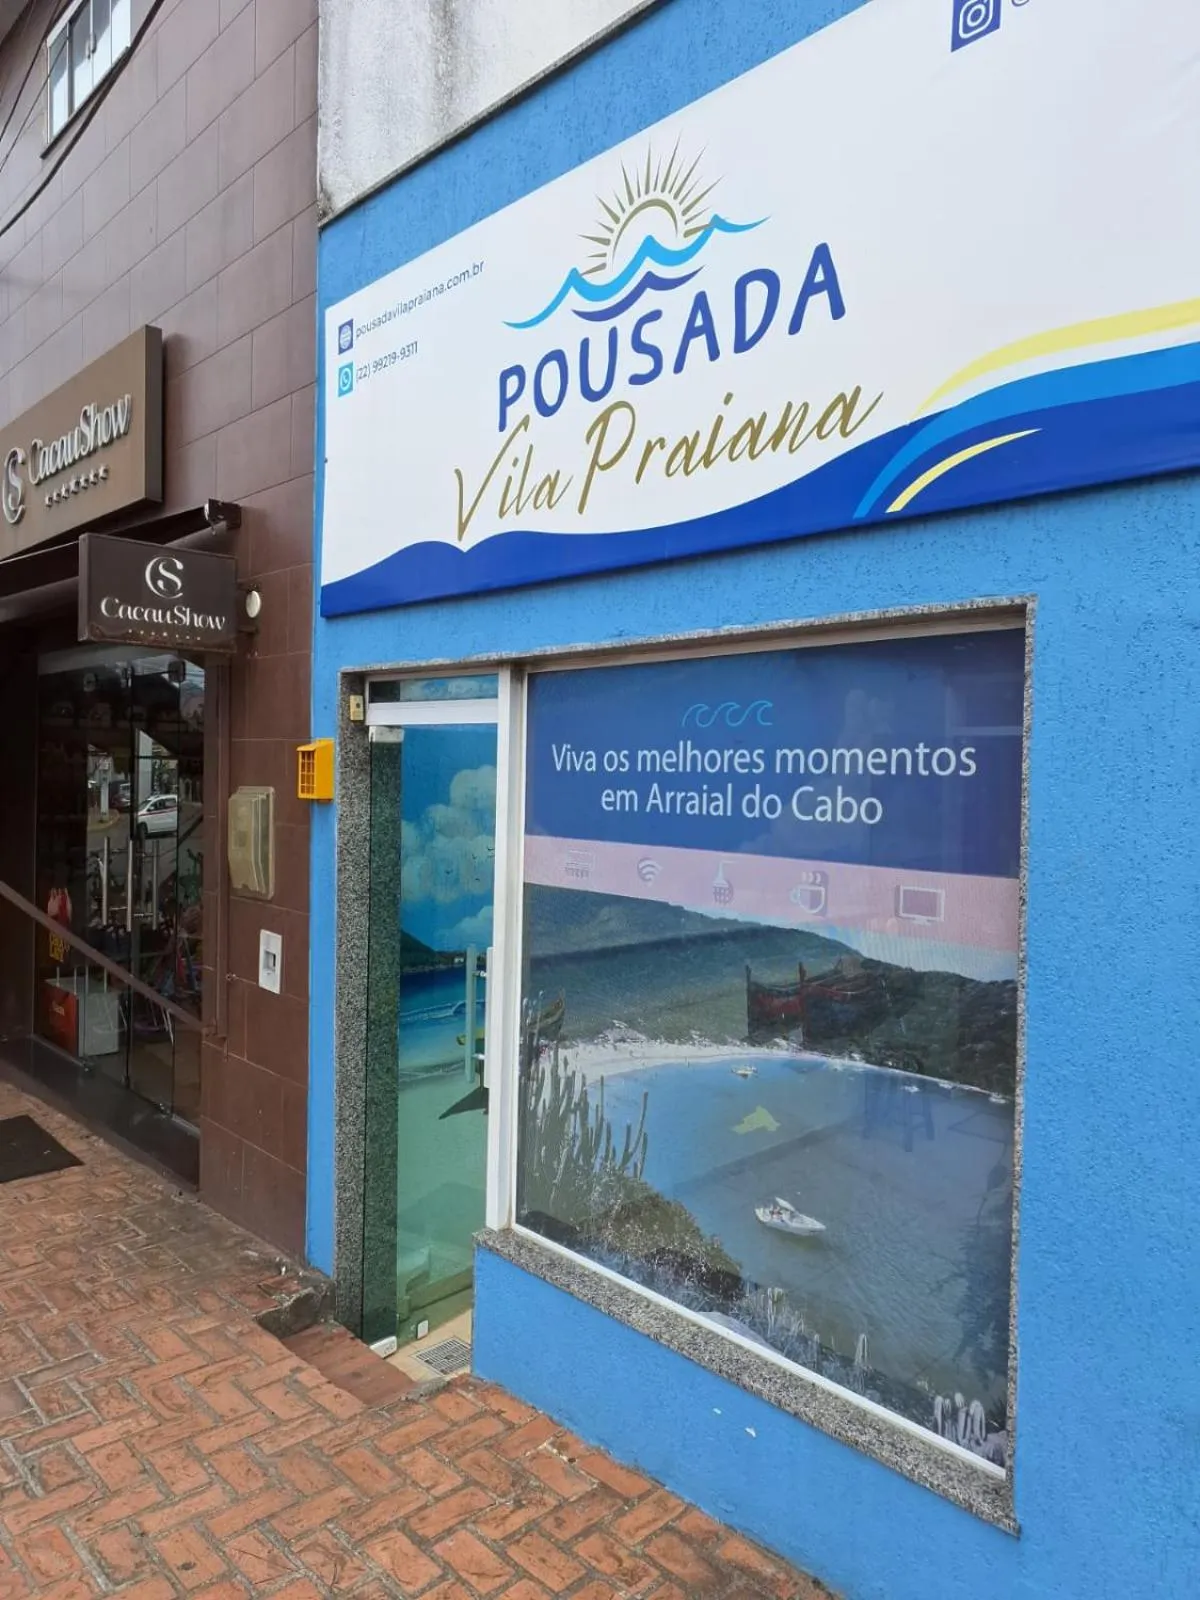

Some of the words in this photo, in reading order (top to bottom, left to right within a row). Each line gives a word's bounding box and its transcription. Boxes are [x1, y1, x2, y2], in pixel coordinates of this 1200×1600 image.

[355, 260, 485, 339] pousadavilapraiana.com.br
[355, 363, 371, 382] (22)
[372, 340, 419, 375] 99219-9311
[498, 241, 846, 433] POUSADA
[454, 414, 573, 543] Vila
[577, 385, 885, 516] Praiana
[551, 743, 597, 773] Viva
[603, 749, 630, 774] os
[637, 740, 766, 775] melhores
[774, 741, 978, 777] momentos
[600, 785, 639, 813] em
[645, 782, 733, 817] Arraial
[741, 784, 783, 820] do
[791, 786, 884, 825] Cabo
